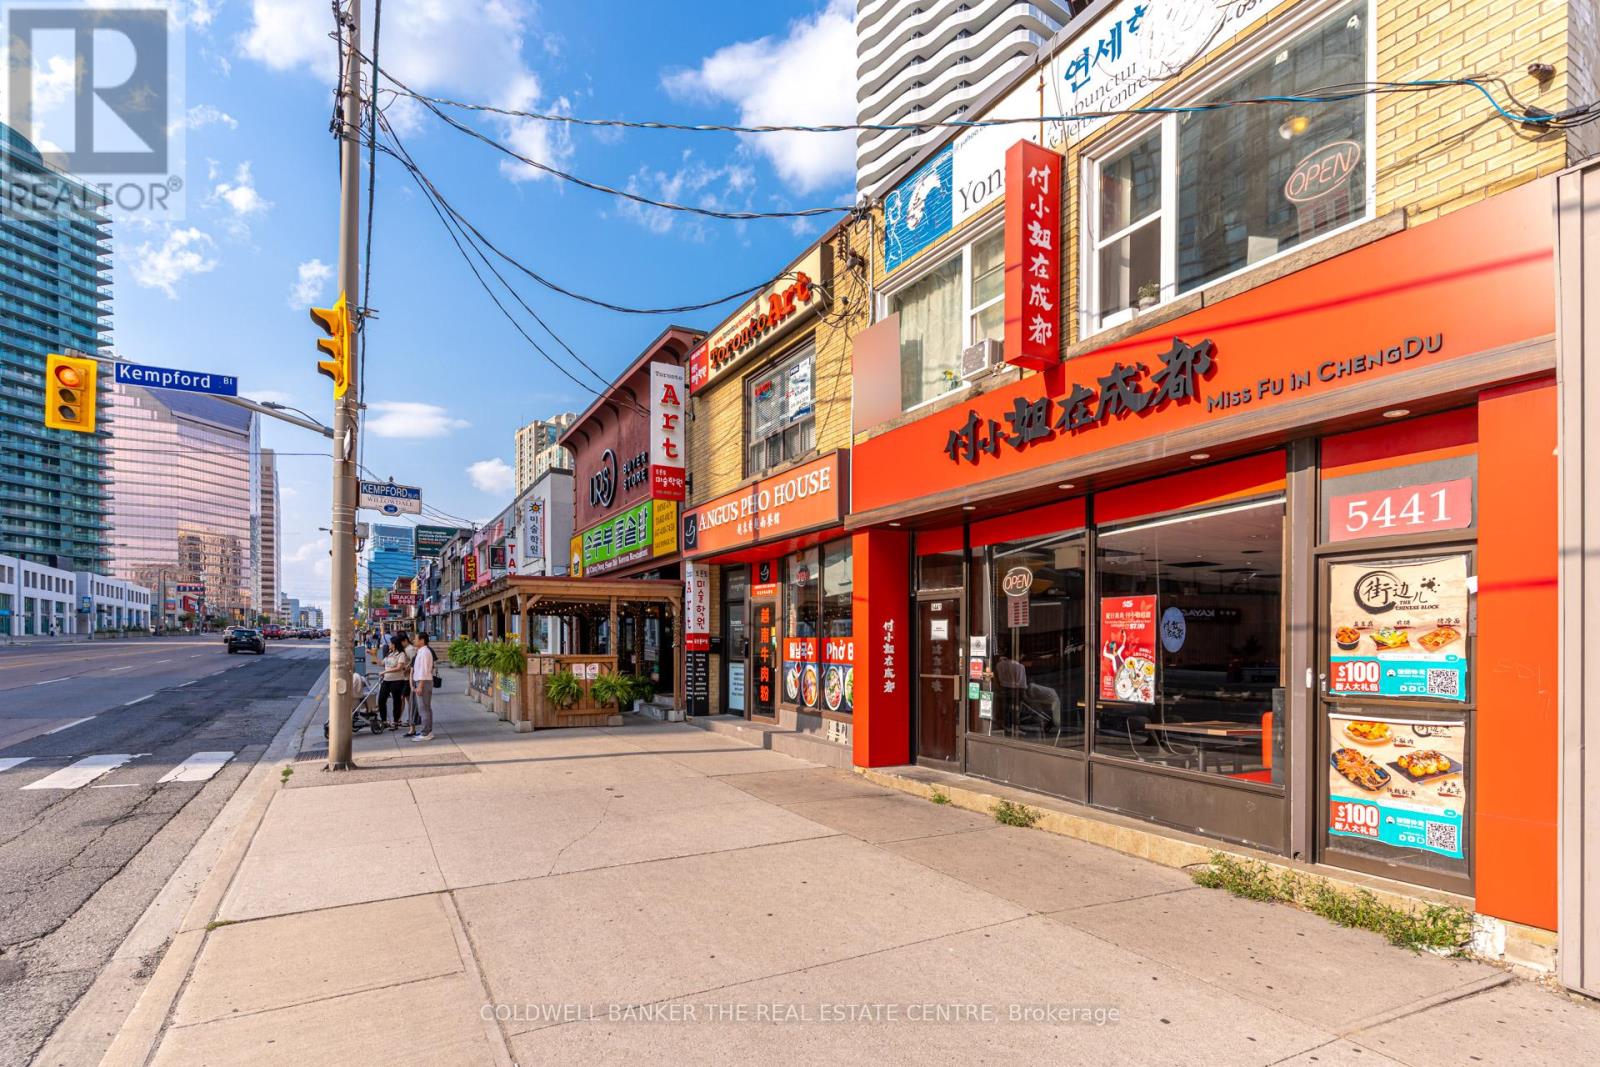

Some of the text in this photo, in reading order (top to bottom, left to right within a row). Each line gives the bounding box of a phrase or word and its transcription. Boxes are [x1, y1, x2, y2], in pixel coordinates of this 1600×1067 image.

[1289, 146, 1353, 196] OPEN
[958, 168, 1005, 213] Yon
[1028, 164, 1053, 346] 付小姐在成都
[119, 364, 211, 389] Kempford
[945, 336, 1213, 462] 付小姐在成都
[660, 384, 680, 458] Art
[362, 483, 408, 497] KEMPFORD
[624, 469, 647, 490] STORE
[655, 476, 683, 487] 미술학원
[698, 501, 739, 532] ANGUS
[740, 490, 770, 518] PHO
[773, 466, 831, 508] HOUSE
[1346, 488, 1452, 532] 5441
[530, 516, 538, 555] 미술학원
[1004, 573, 1030, 590] OPEN
[1363, 577, 1428, 605] 街边儿
[696, 580, 706, 630] 미술학원
[789, 642, 814, 660] 월남국수
[1338, 661, 1380, 683] $100
[1337, 802, 1379, 827] $100
